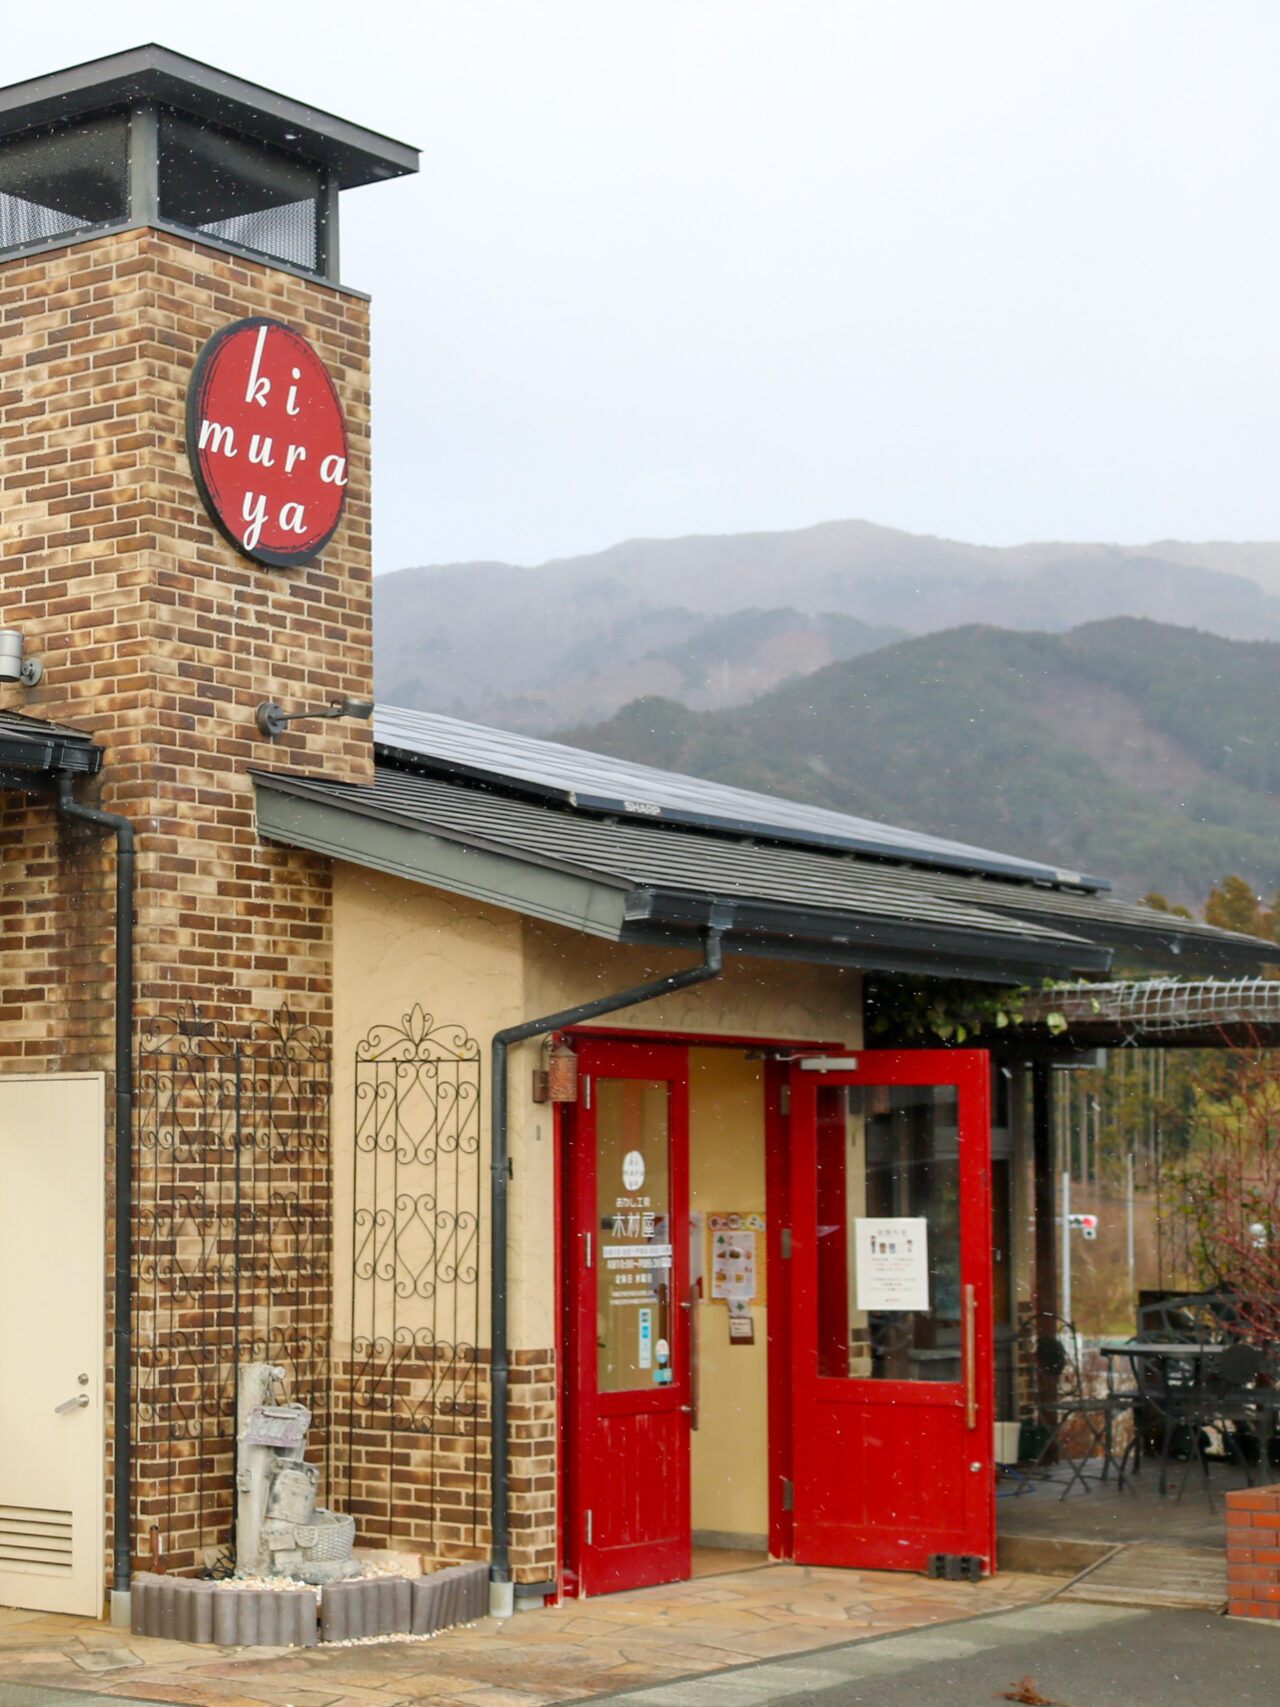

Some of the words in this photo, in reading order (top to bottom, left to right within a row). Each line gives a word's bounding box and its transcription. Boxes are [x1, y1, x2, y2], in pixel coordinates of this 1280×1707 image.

[245, 325, 300, 416] ki
[197, 419, 348, 487] mura
[241, 491, 308, 551] ya
[624, 800, 661, 816] SHARP
[611, 1211, 656, 1239] 木村屋
